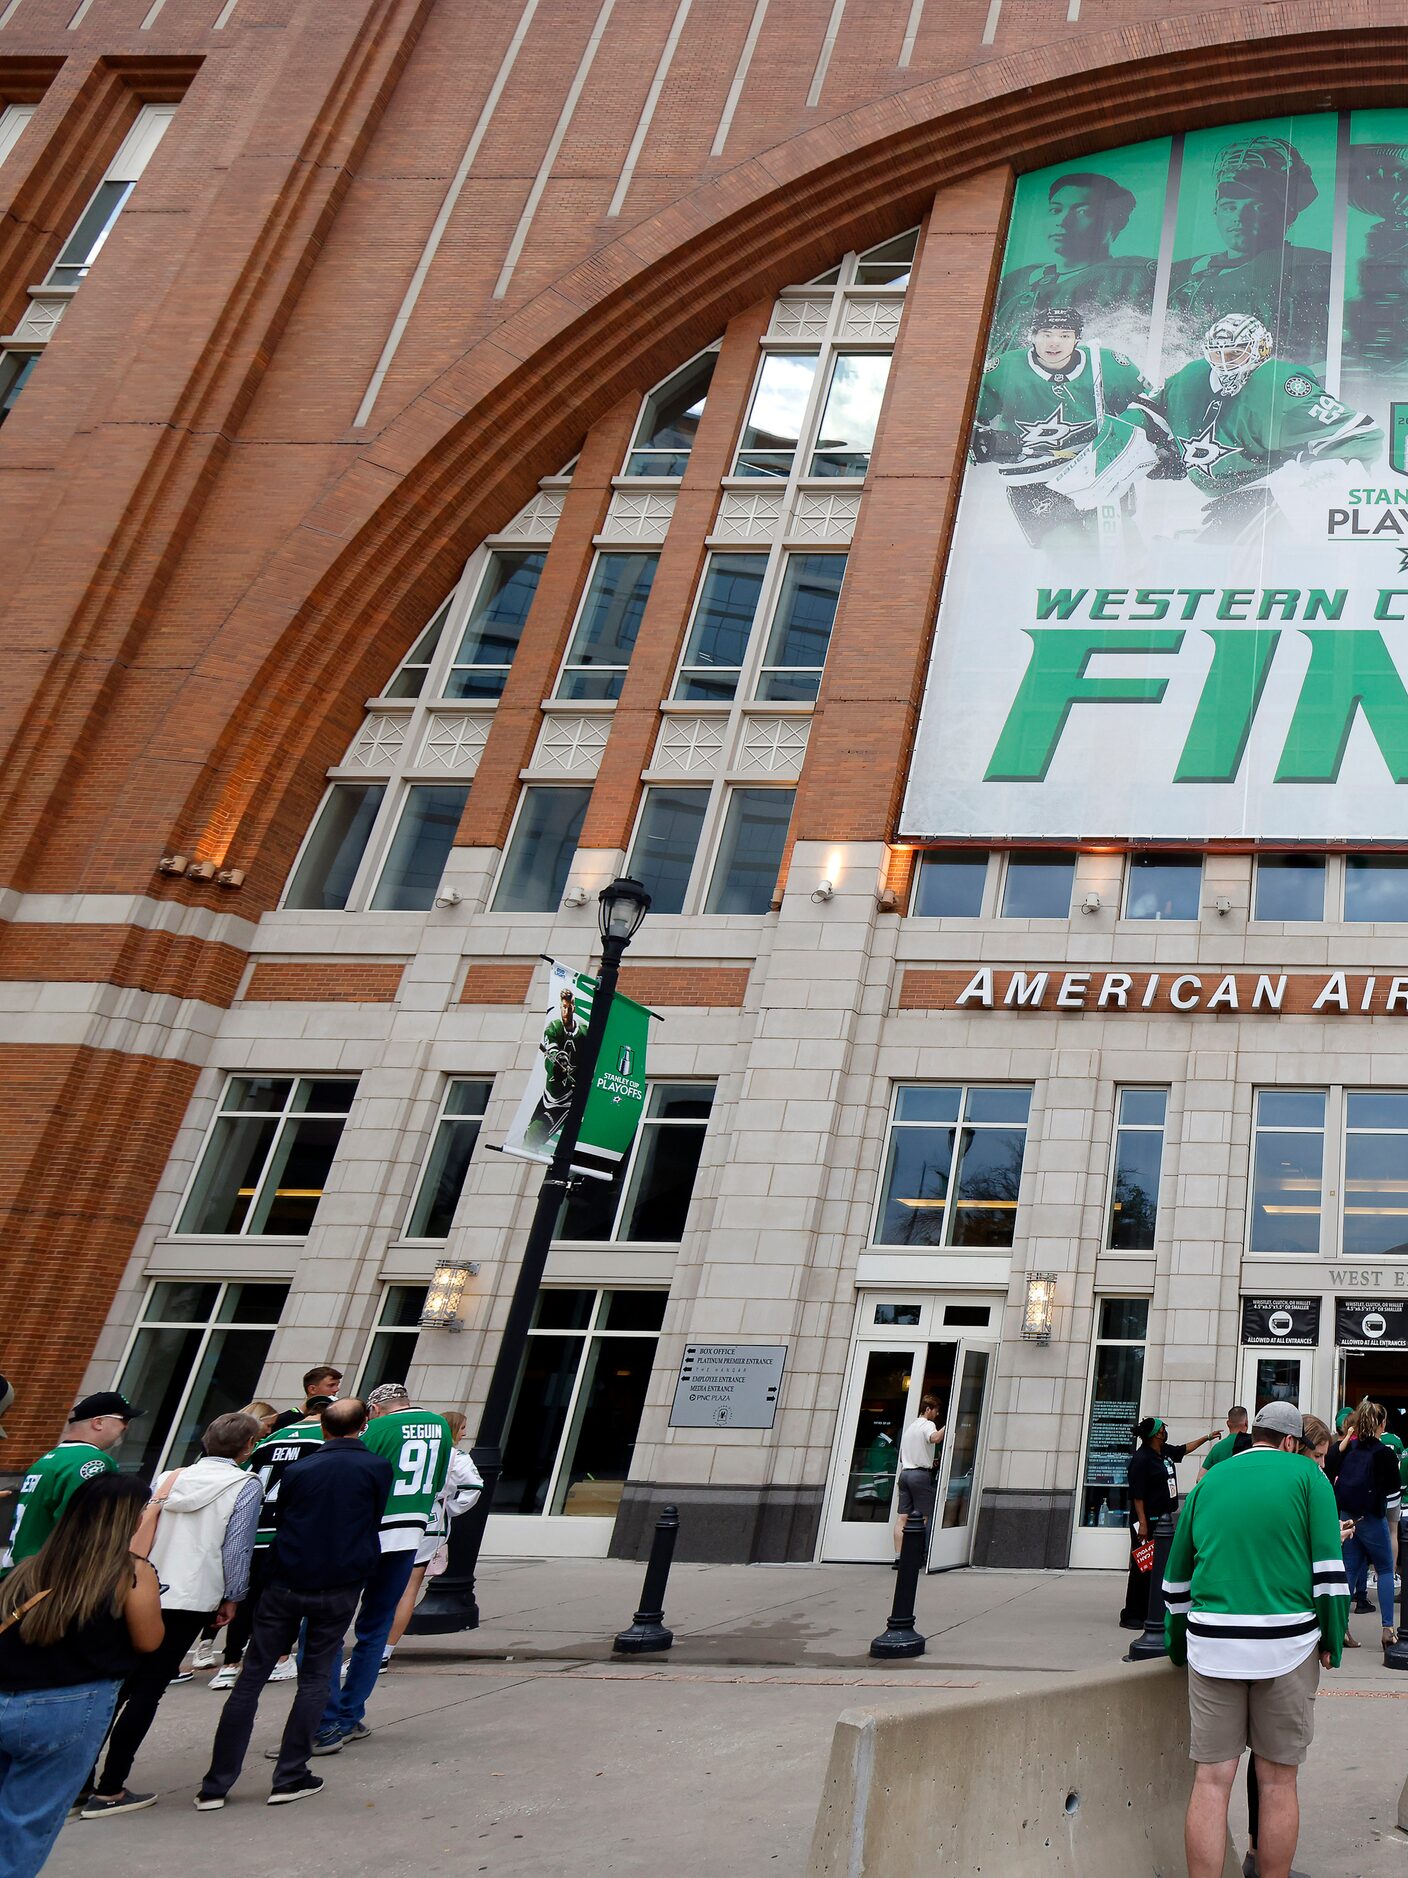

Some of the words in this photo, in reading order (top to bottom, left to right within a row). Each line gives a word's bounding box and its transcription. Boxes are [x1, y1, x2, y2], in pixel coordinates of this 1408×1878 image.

[1308, 395, 1344, 424] 29
[1035, 588, 1349, 621] WESTERN
[955, 967, 1289, 1012] AMERICAN
[597, 1078, 642, 1100] PLAYOFFS
[604, 1072, 630, 1085] STANLEY
[629, 1080, 640, 1089] CUP
[1329, 1270, 1383, 1287] WEST
[402, 1424, 442, 1439] SEGUIN
[271, 1446, 302, 1462] BENN
[393, 1439, 442, 1496] 91
